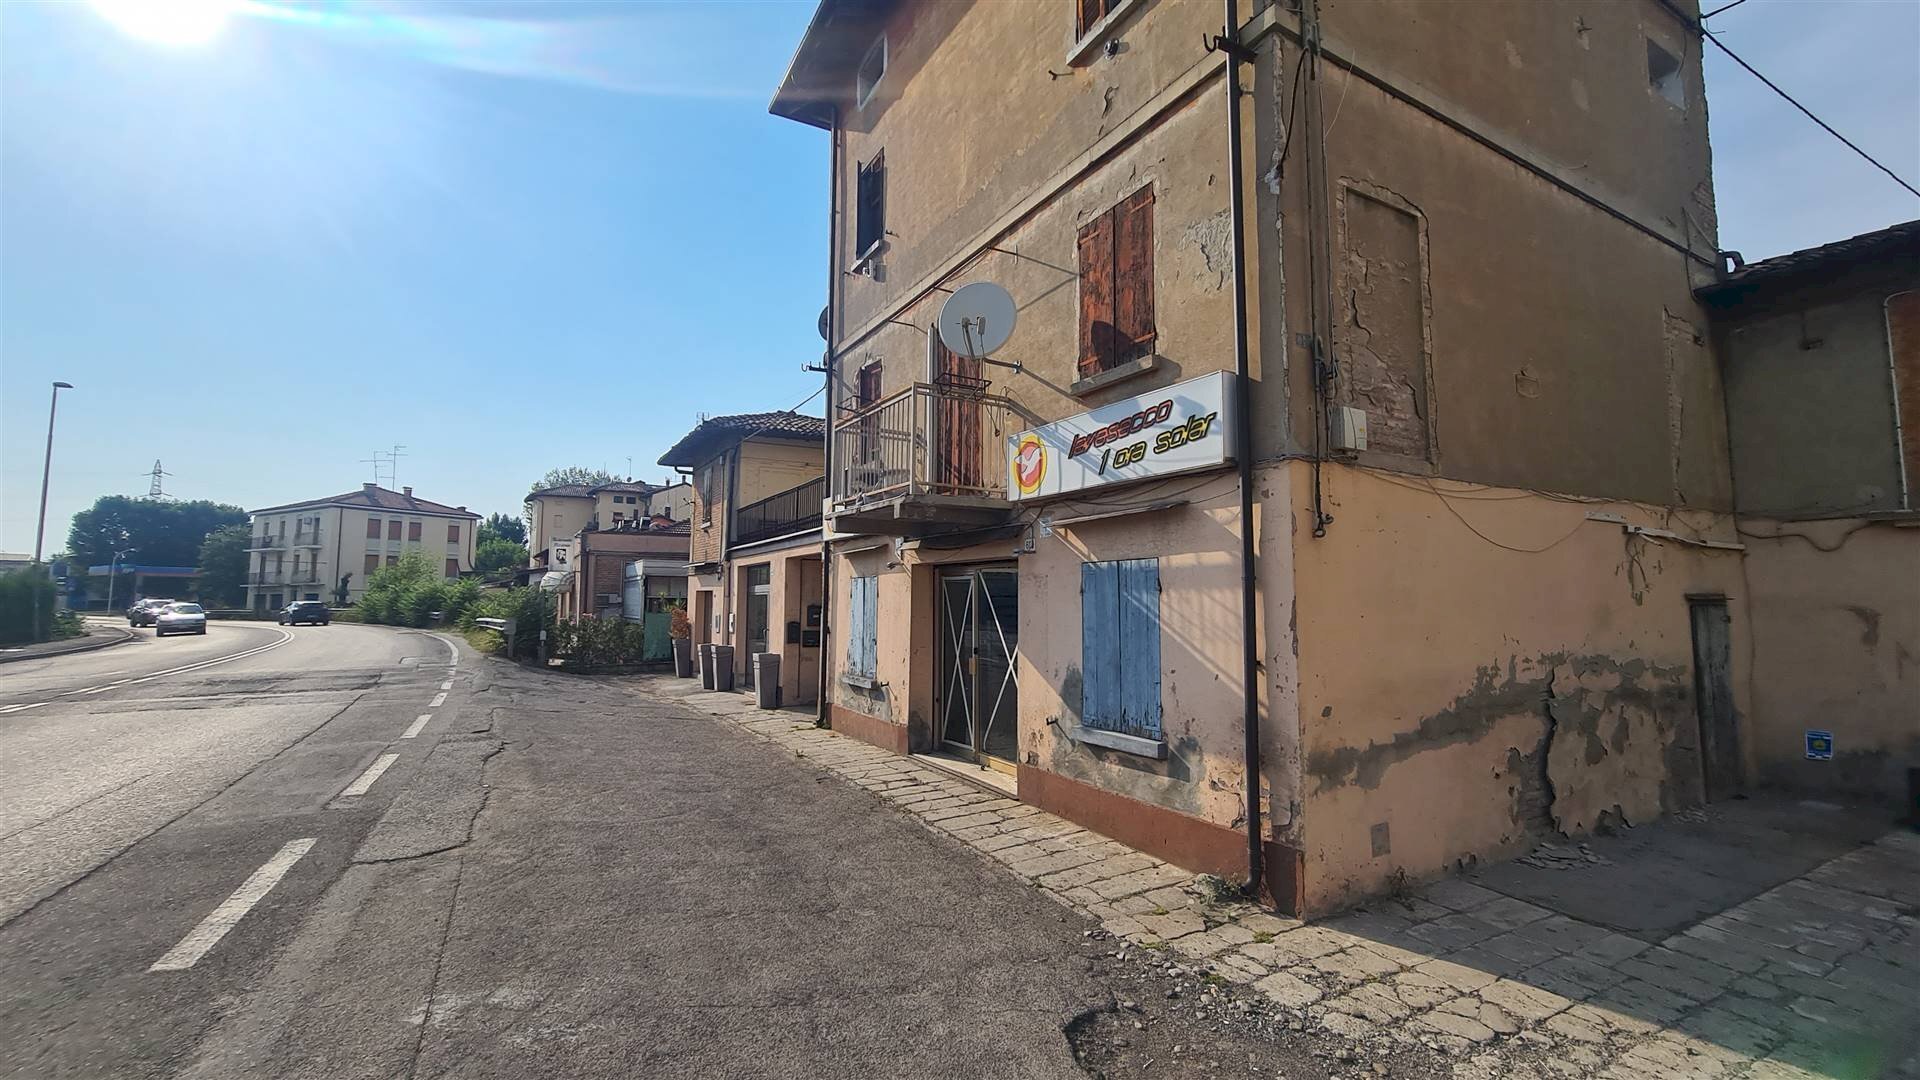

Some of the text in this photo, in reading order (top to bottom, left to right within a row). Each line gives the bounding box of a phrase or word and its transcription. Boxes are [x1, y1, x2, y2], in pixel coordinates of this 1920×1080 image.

[1068, 399, 1174, 460] lavasecco
[1112, 440, 1148, 469] ora
[1153, 412, 1218, 454] solar
